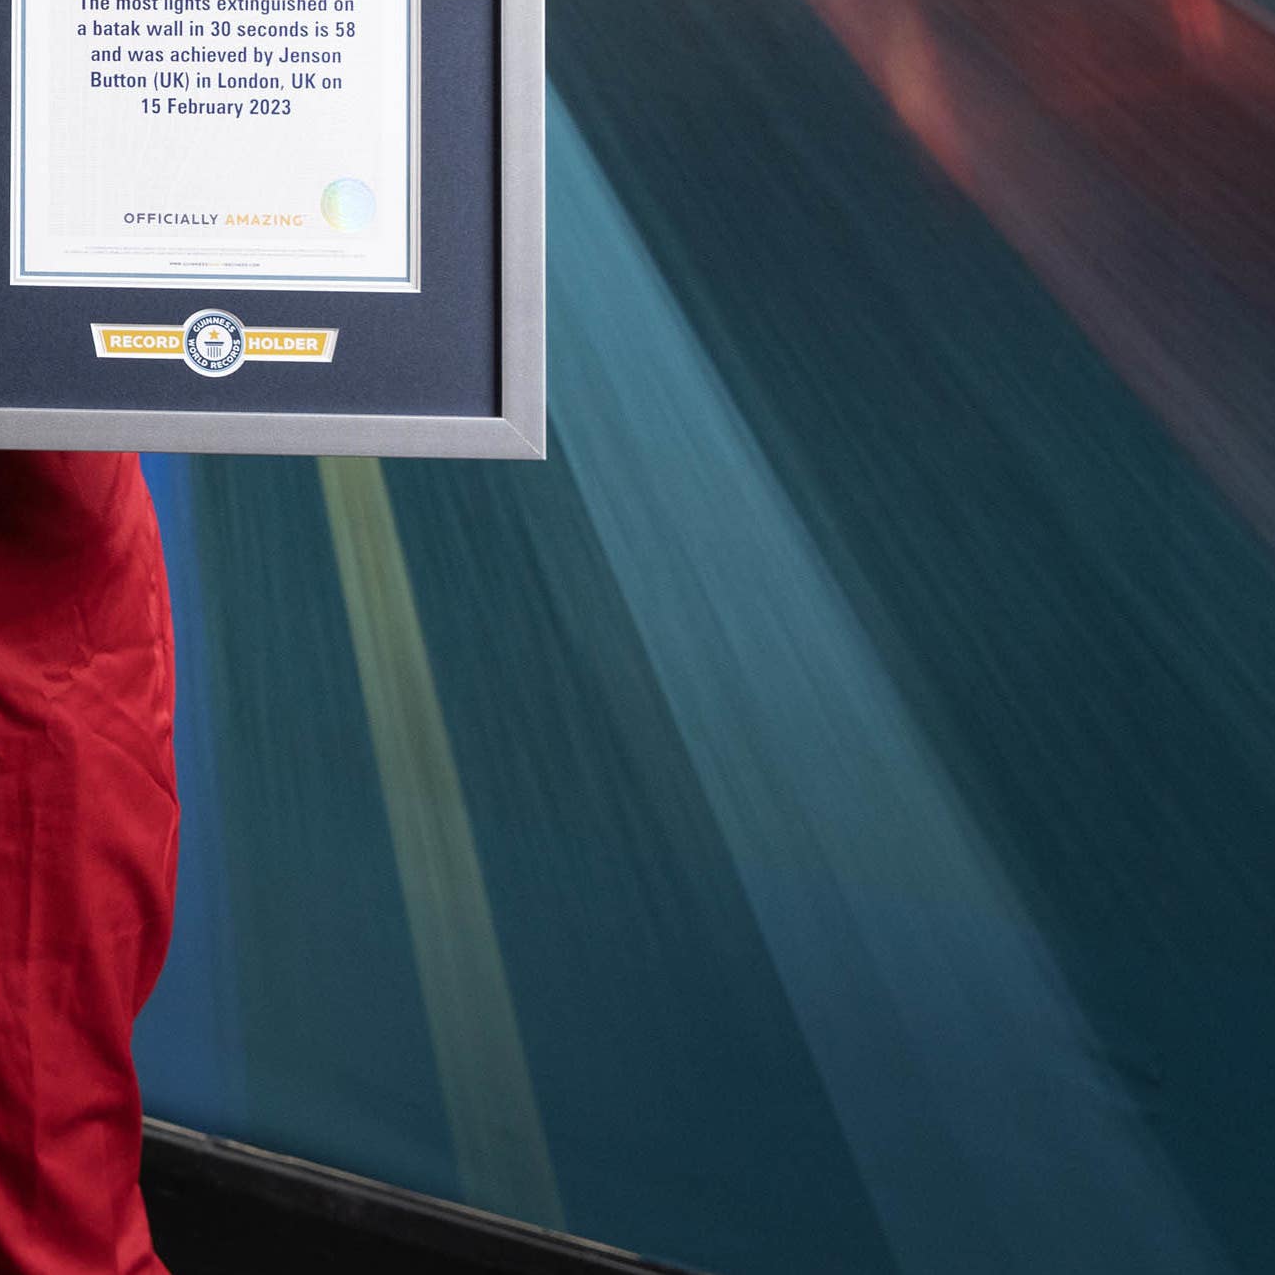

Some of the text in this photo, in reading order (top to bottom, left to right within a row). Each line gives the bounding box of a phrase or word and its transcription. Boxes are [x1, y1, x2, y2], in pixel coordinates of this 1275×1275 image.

[334, 0, 354, 11] on
[77, 21, 355, 38] a batak wall in 30 seconds is 58
[91, 46, 342, 66] and was achieved by Jenson
[90, 72, 342, 91] Button (UK) in London, UK on
[141, 98, 291, 118] 15 February 2023
[123, 212, 304, 227] OFFICIALLY AMAZING
[192, 316, 236, 334] GUINNESS
[110, 334, 318, 351] RECORD HOLDER
[187, 338, 242, 370] WORLD RECORDS
